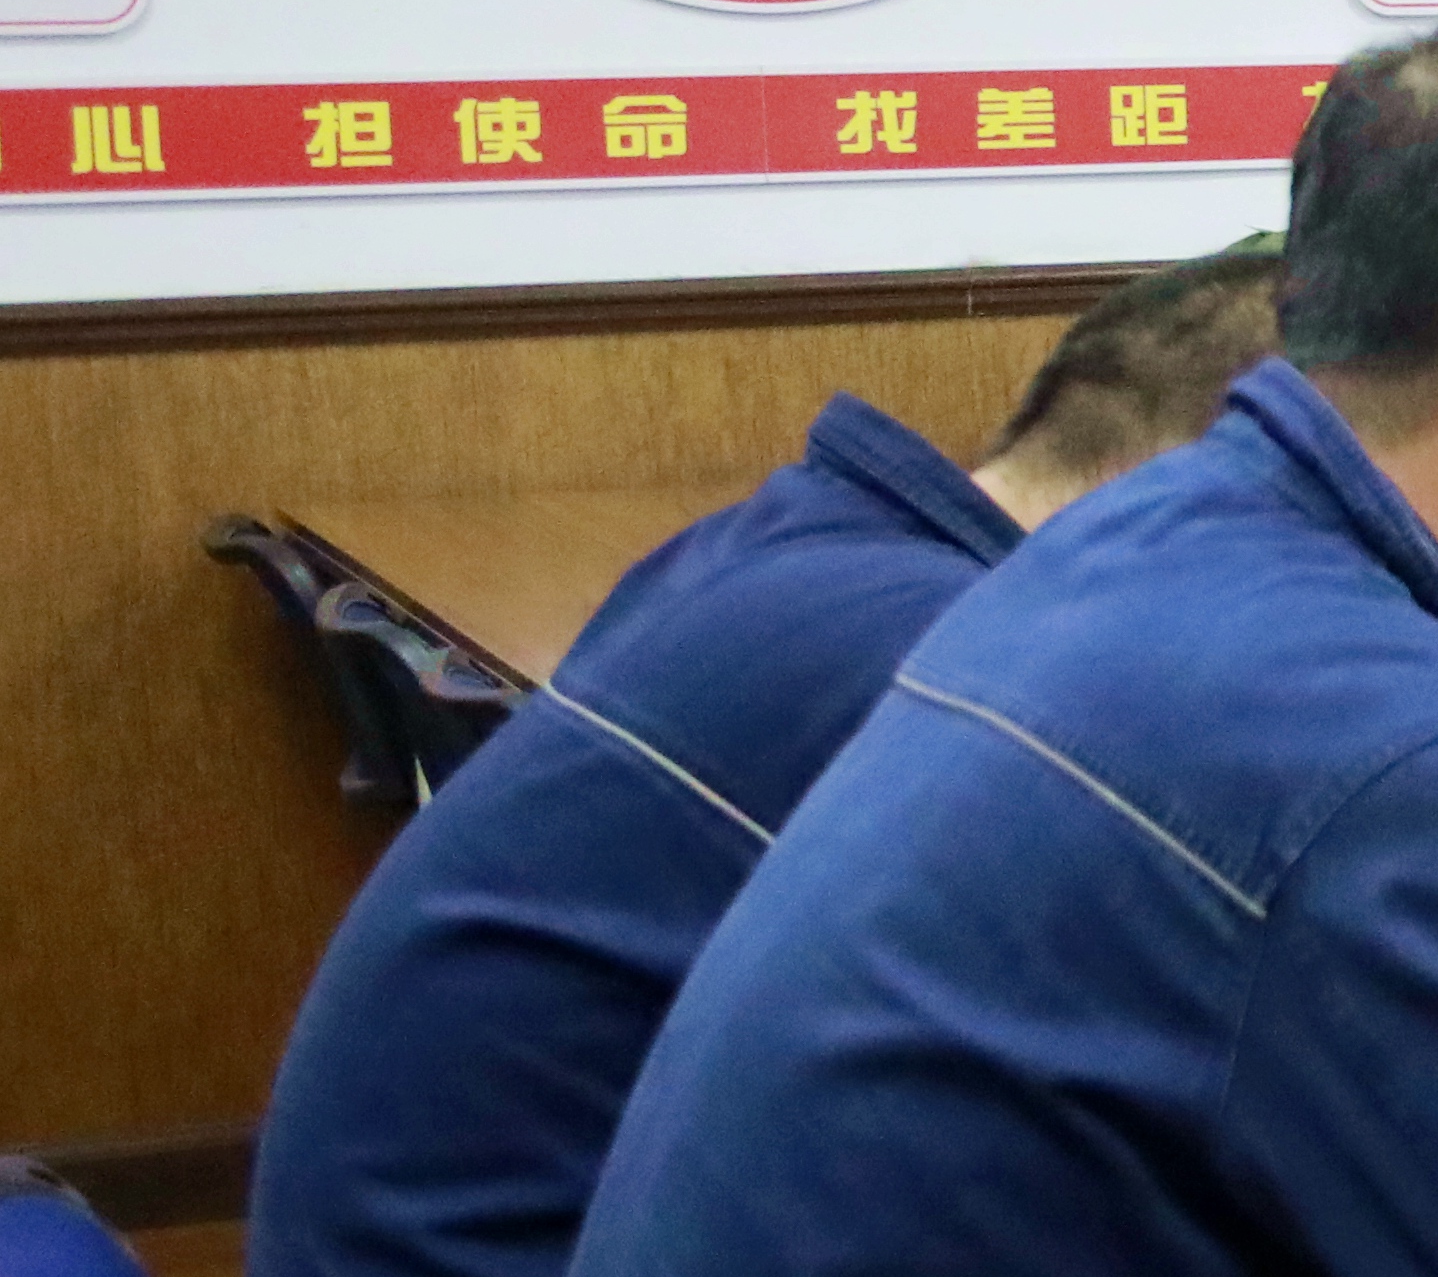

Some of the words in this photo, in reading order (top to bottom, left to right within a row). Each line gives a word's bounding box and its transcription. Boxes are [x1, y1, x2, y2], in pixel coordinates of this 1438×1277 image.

[304, 94, 690, 168] 担使命
[835, 83, 1188, 156] 找差距
